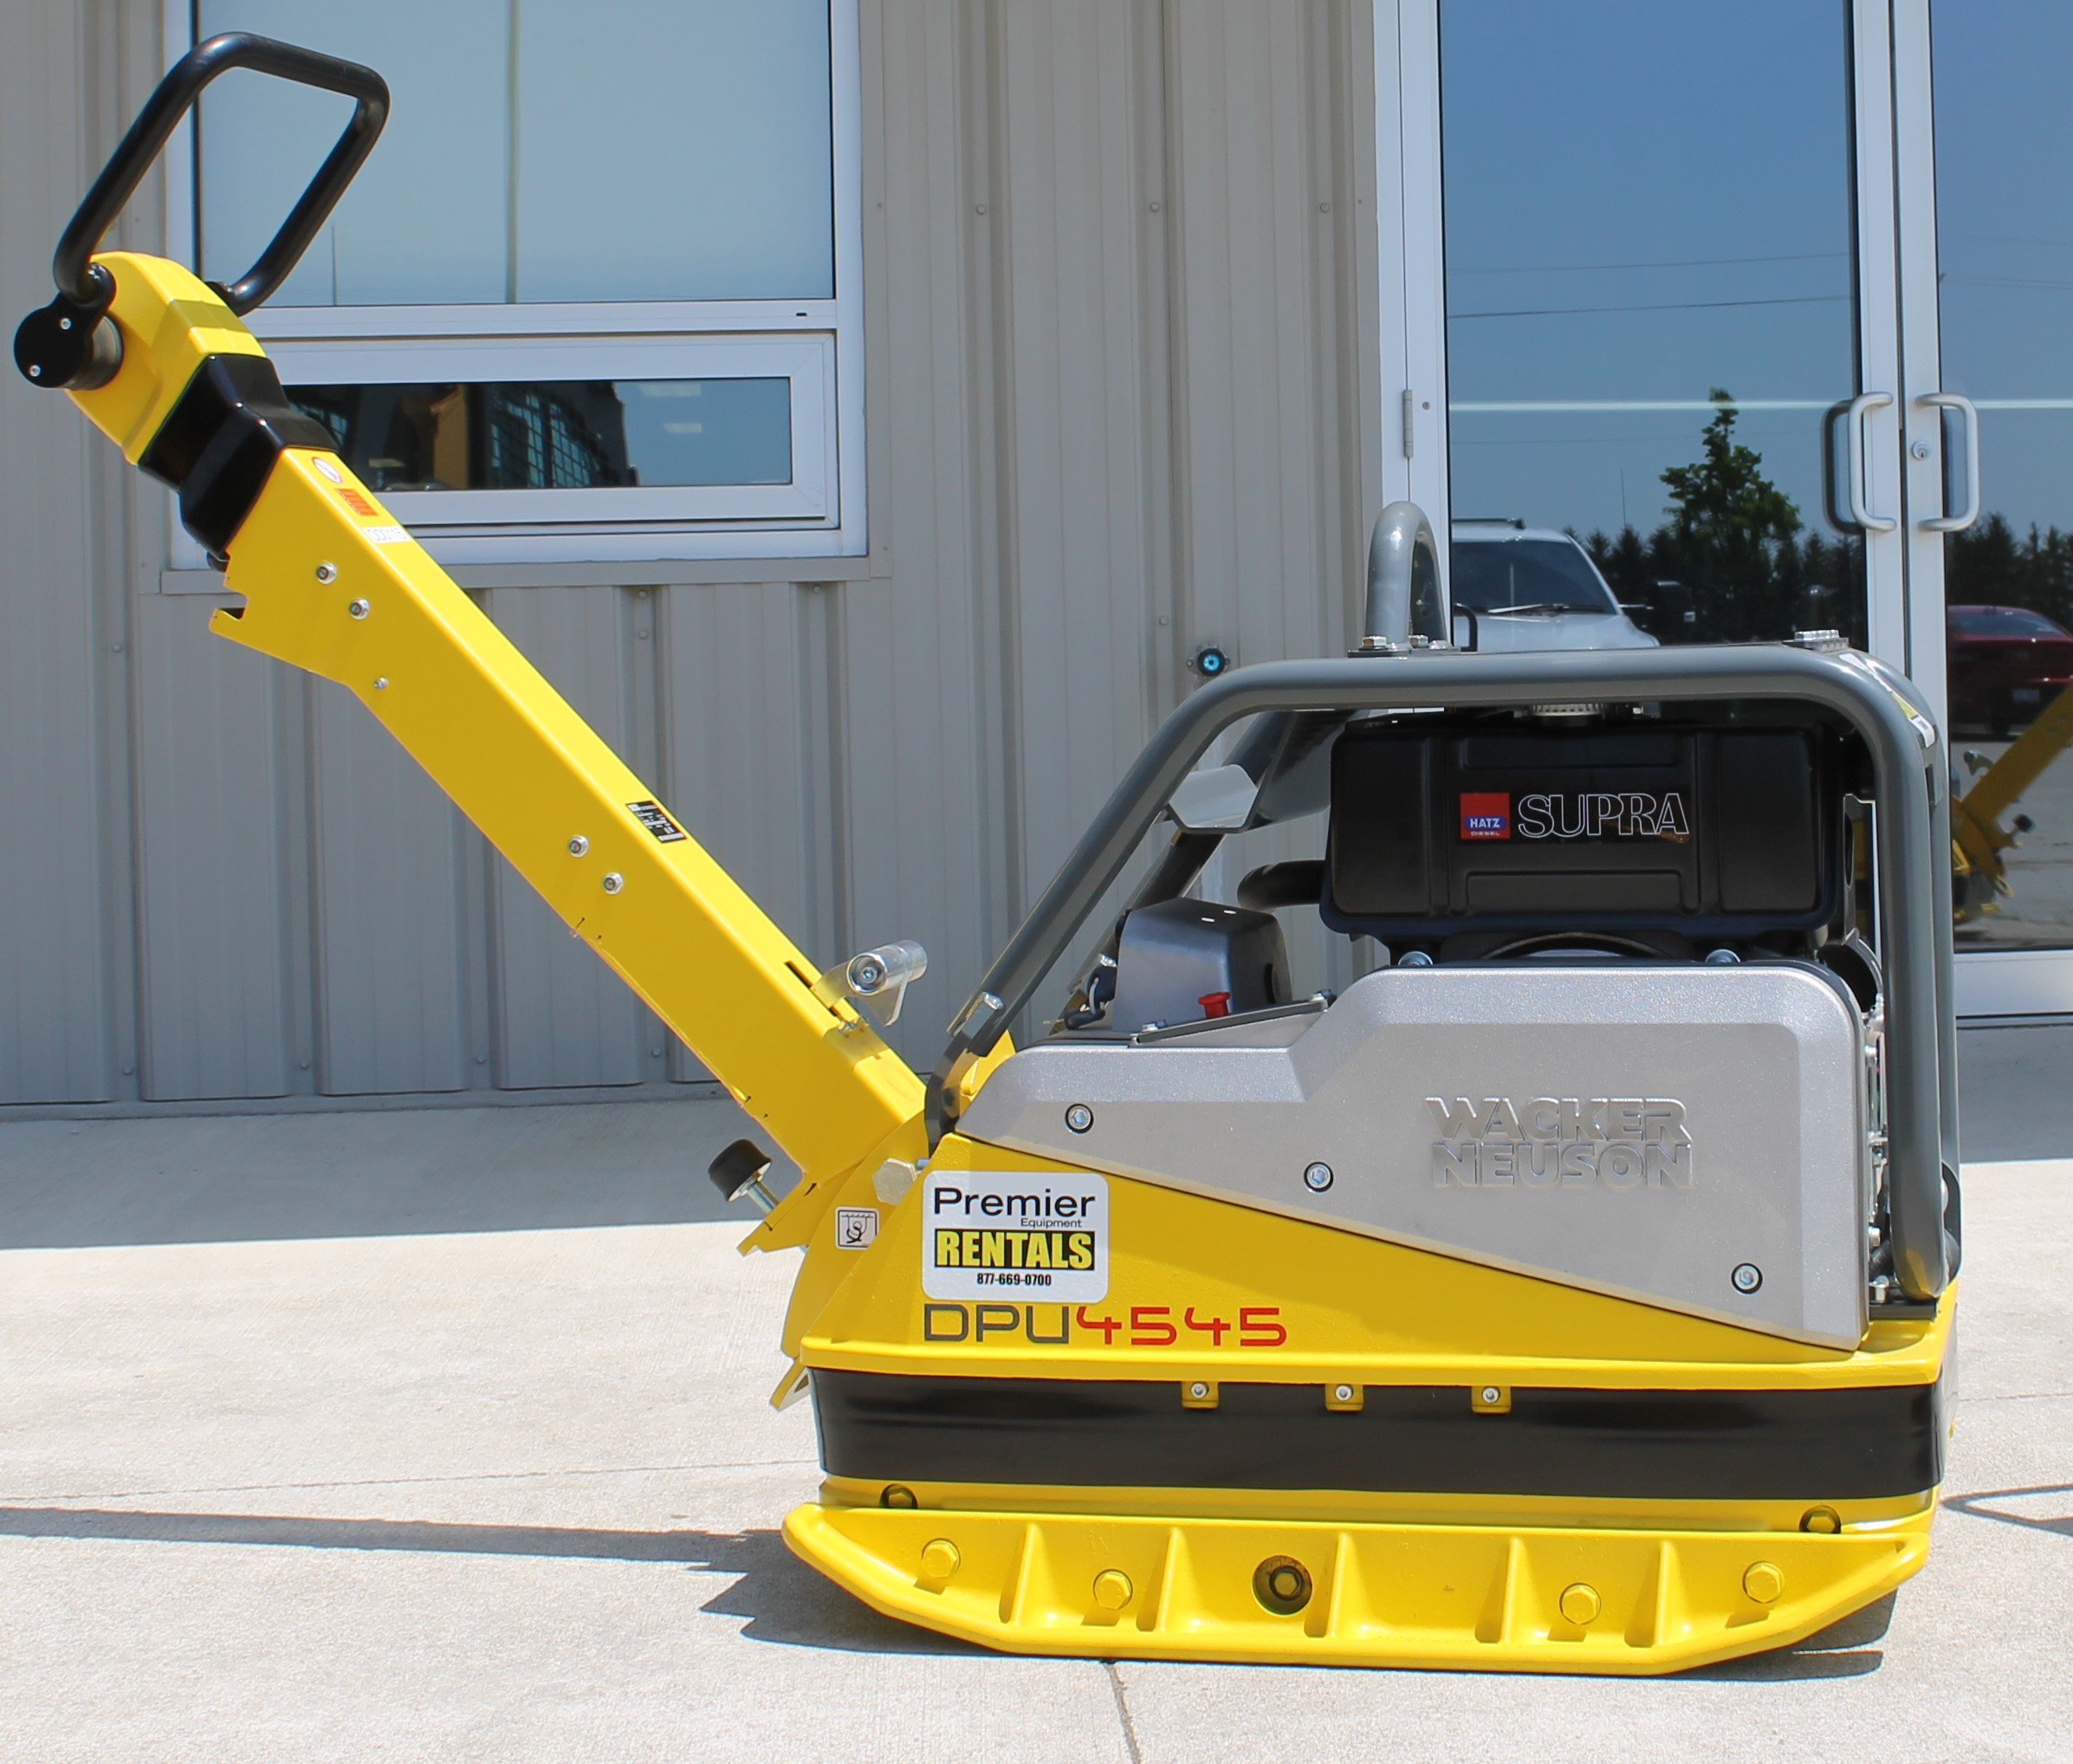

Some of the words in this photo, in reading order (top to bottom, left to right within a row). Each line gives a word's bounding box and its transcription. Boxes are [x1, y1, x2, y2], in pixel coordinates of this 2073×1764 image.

[1469, 817, 1500, 828] HATZ
[1518, 792, 1690, 838] SUPRA
[1425, 1095, 1693, 1141] WACKER
[1432, 1143, 1693, 1189] NEUSON
[934, 1187, 1096, 1217] Premier
[1020, 1217, 1083, 1229] Equipment
[936, 1230, 1092, 1269] RENTALS
[976, 1273, 1053, 1287] 877-669-0700
